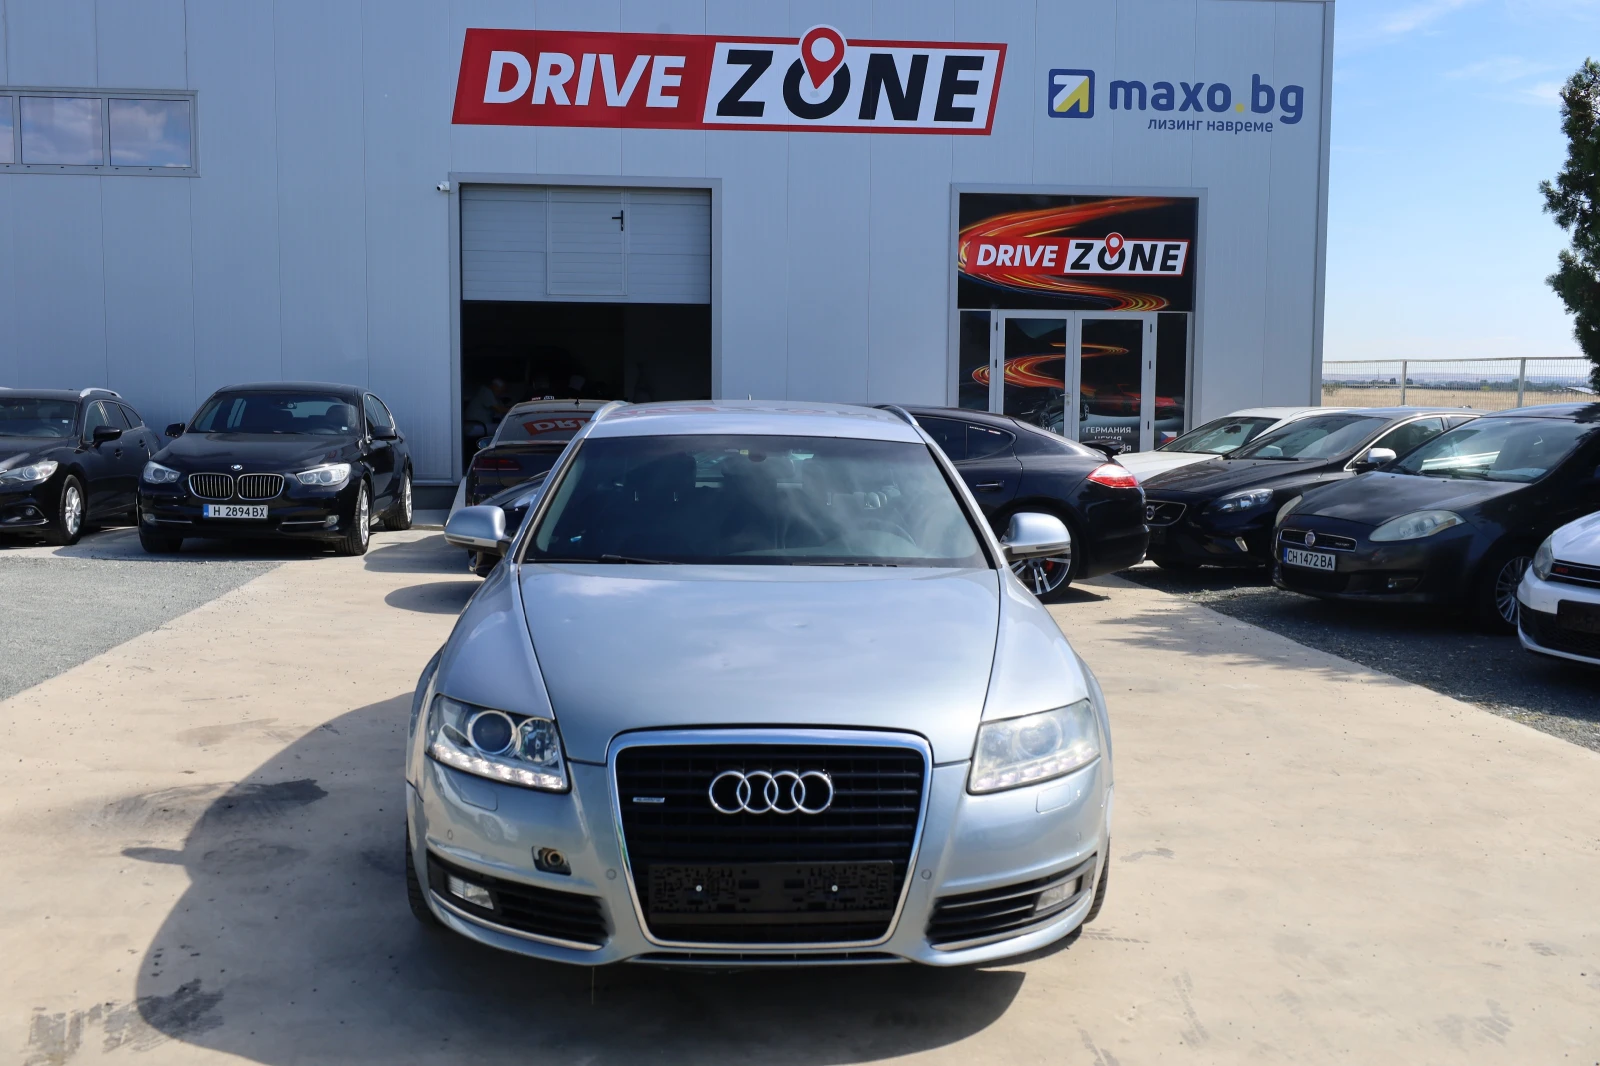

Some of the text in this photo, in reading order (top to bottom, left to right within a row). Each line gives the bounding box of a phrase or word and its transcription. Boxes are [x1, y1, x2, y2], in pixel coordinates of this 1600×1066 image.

[483, 49, 985, 122] DRIVE ZONE
[1109, 73, 1304, 125] maxo.bg
[1148, 118, 1274, 135] лизинг навреме
[976, 242, 1181, 271] DRIVE ZONE
